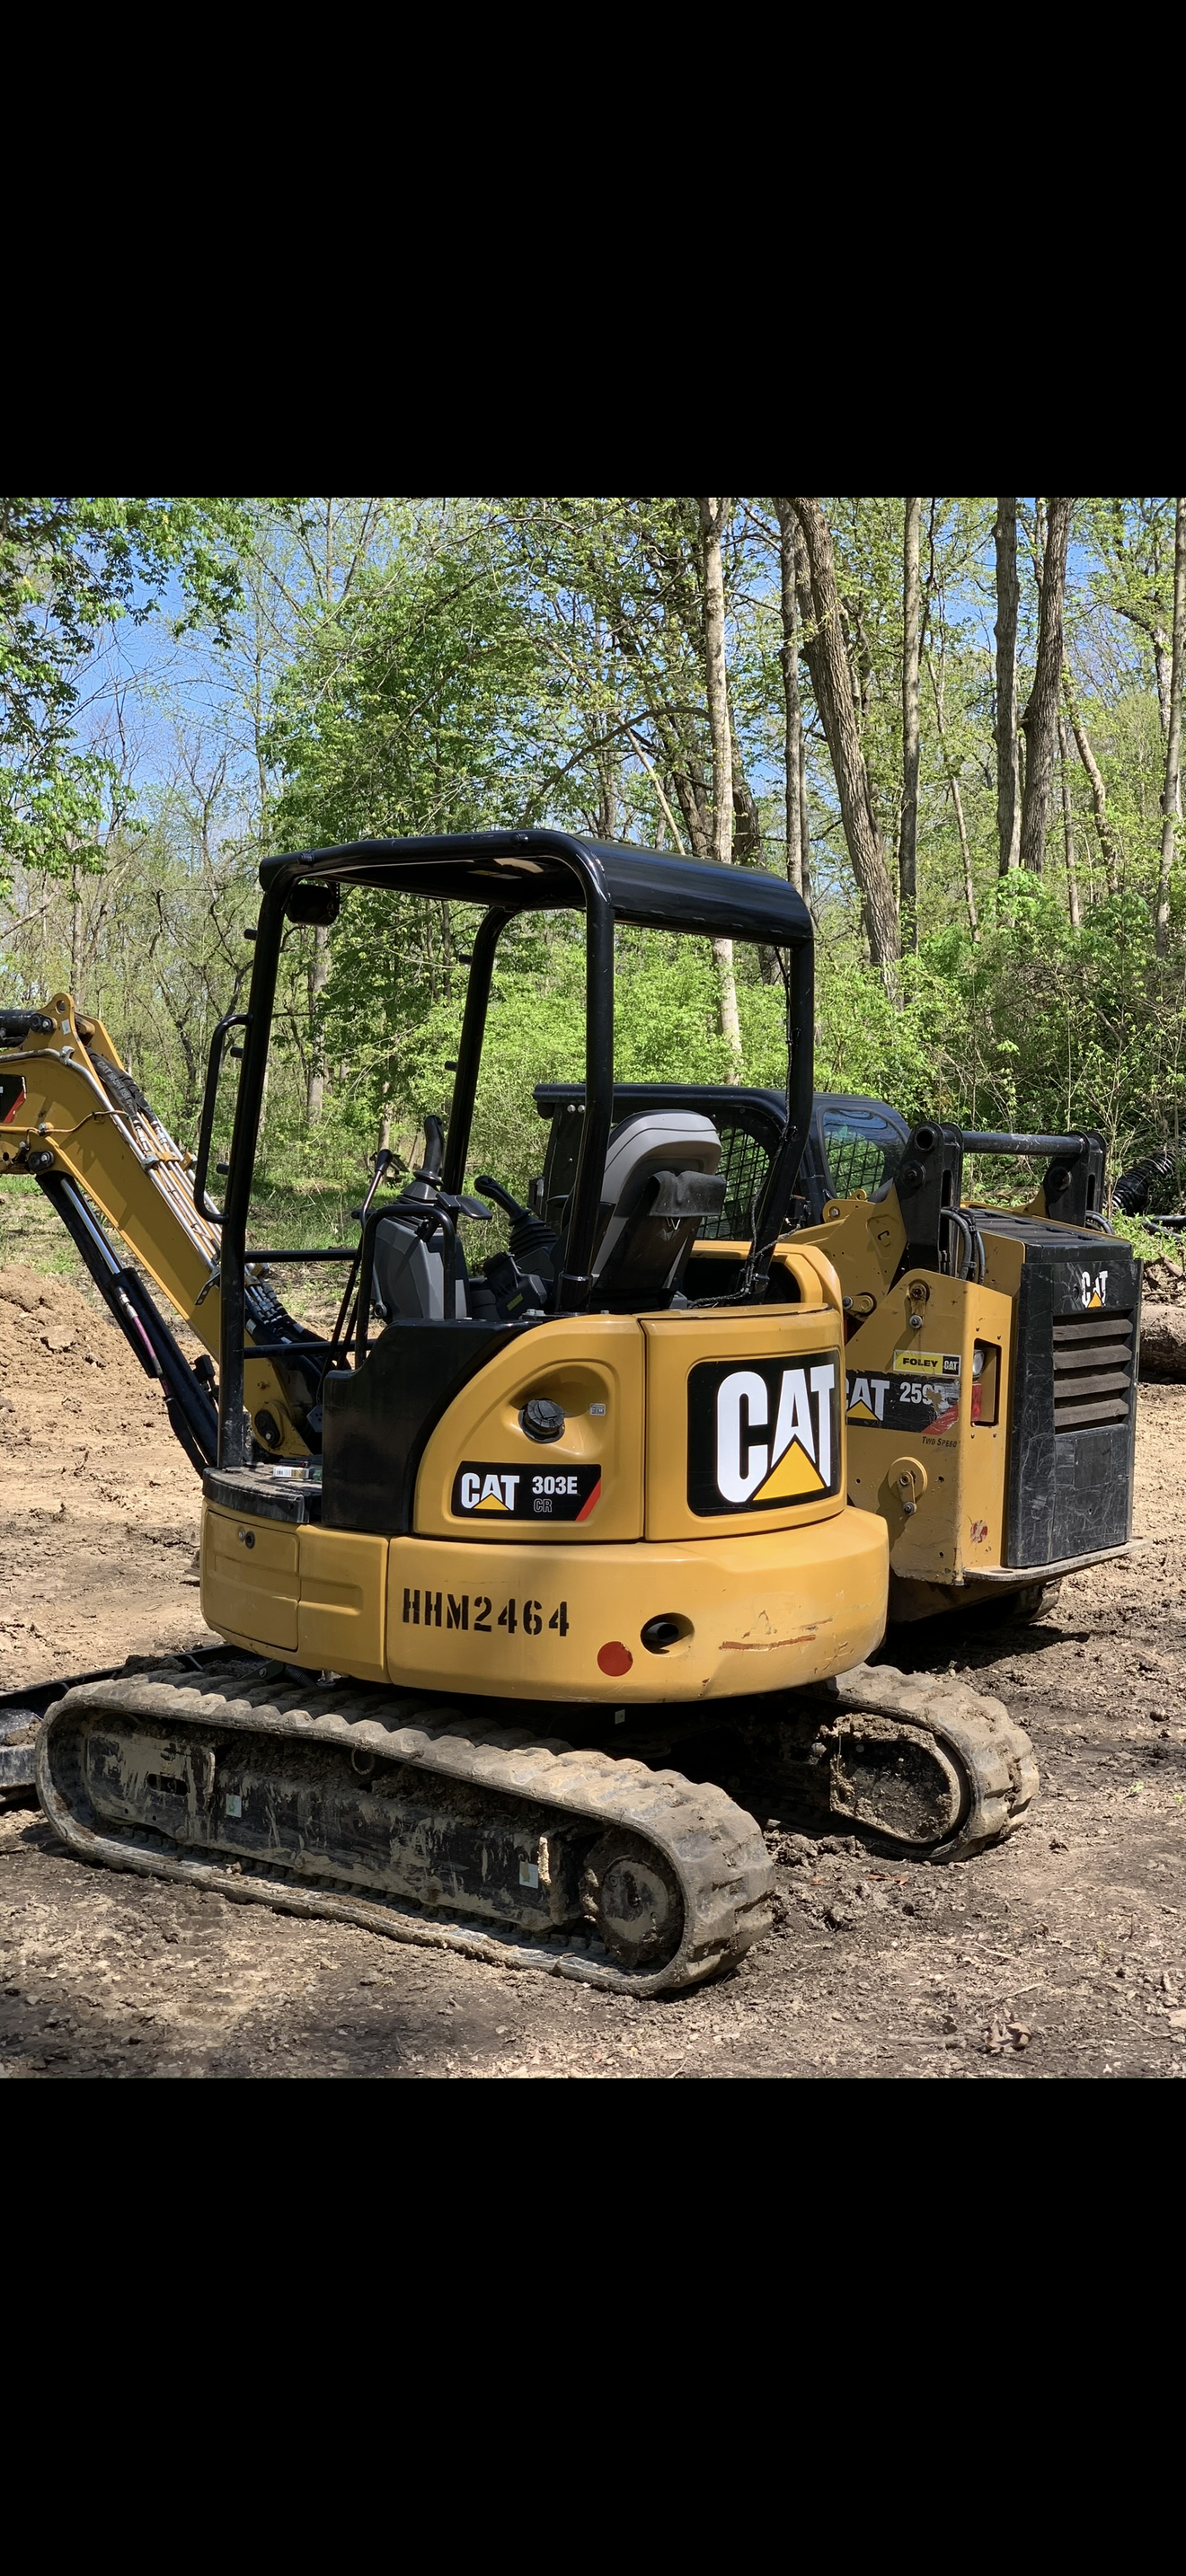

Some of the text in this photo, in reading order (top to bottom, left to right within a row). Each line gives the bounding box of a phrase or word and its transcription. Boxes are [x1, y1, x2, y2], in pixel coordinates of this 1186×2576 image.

[902, 1357, 959, 1372] FOLEY CAT
[845, 1377, 890, 1422] AT
[717, 1363, 836, 1503] CAT
[461, 1472, 578, 1512] CAT 303E
[533, 1497, 553, 1513] CR
[403, 1587, 570, 1637] HHM2464
